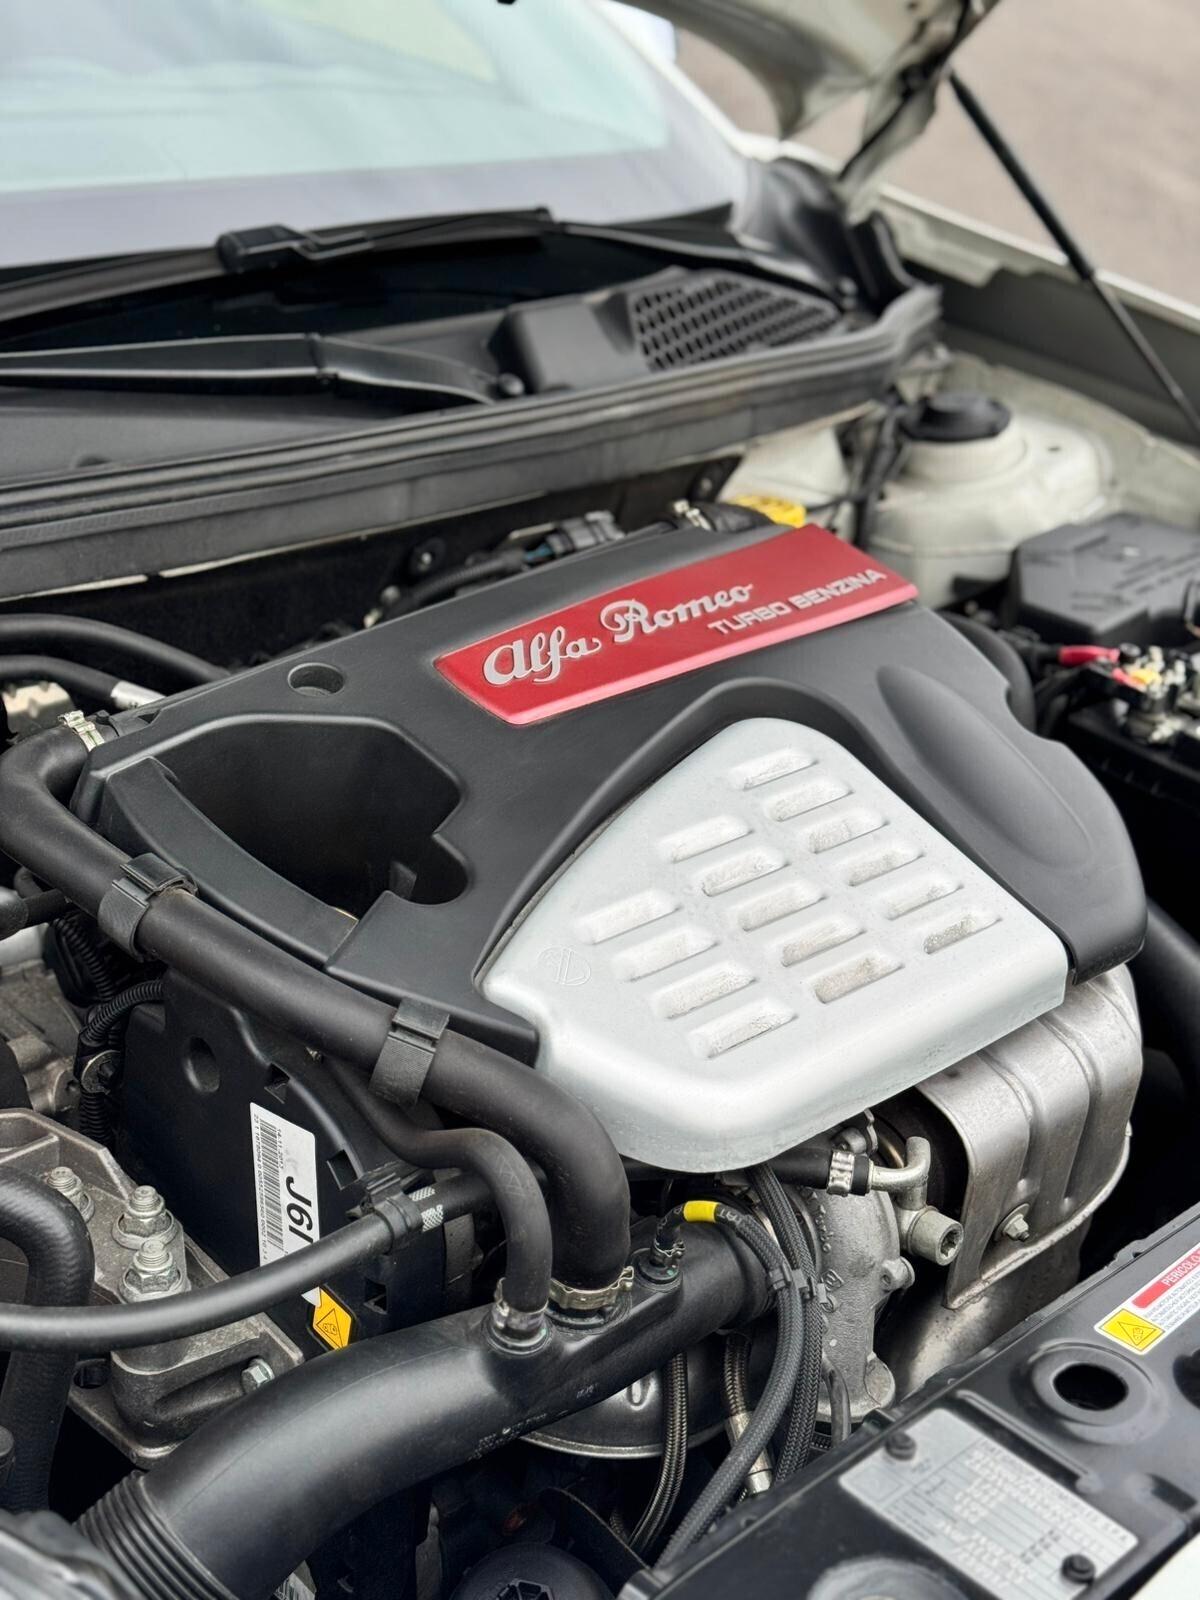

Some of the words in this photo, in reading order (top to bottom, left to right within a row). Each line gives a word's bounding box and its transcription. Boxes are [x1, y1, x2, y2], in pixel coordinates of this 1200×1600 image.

[483, 626, 602, 685] Alfa
[600, 584, 753, 643] Romeo
[707, 601, 792, 635] TURBO
[788, 568, 887, 609] BENZINA
